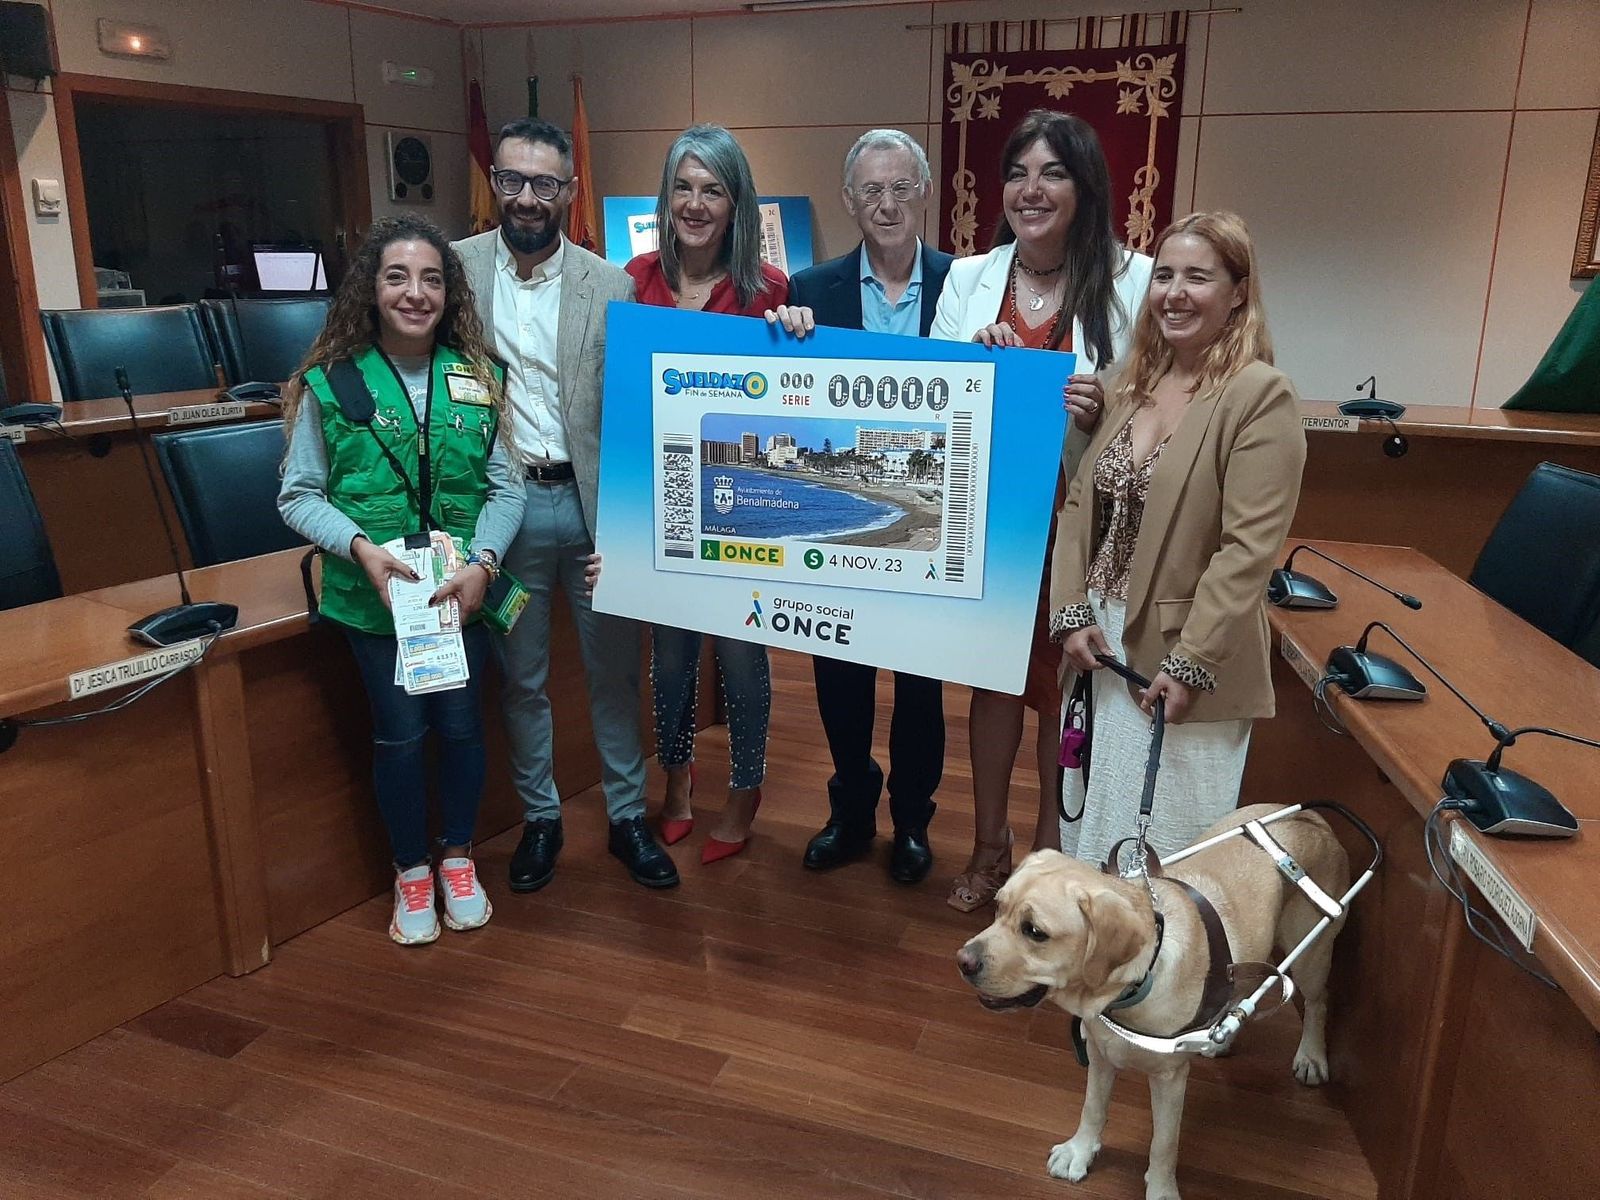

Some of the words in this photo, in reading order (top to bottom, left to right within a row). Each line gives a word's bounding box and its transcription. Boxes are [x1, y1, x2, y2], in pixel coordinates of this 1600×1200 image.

[662, 368, 768, 399] SUELDAZO
[780, 372, 814, 389] 000
[965, 379, 982, 393] 2€
[685, 389, 699, 397] FIN
[708, 390, 743, 399] SEMANA
[782, 394, 811, 406] SERIE
[828, 374, 949, 411] 00000
[182, 409, 200, 420] JUAN
[202, 407, 220, 418] OLEA
[737, 486, 774, 495] Ayuntamiento
[775, 488, 783, 496] de
[736, 494, 800, 510] Benalmádena
[704, 524, 737, 534] MÁLAGA
[724, 545, 779, 563] ONCE
[829, 554, 838, 567] 4
[842, 555, 881, 571] NOV.
[885, 558, 903, 573] 23
[773, 597, 813, 612] grupo
[816, 606, 854, 620] social
[771, 612, 852, 645] ONCE
[87, 668, 118, 690] JESICA
[118, 657, 158, 680] TRUJILLO
